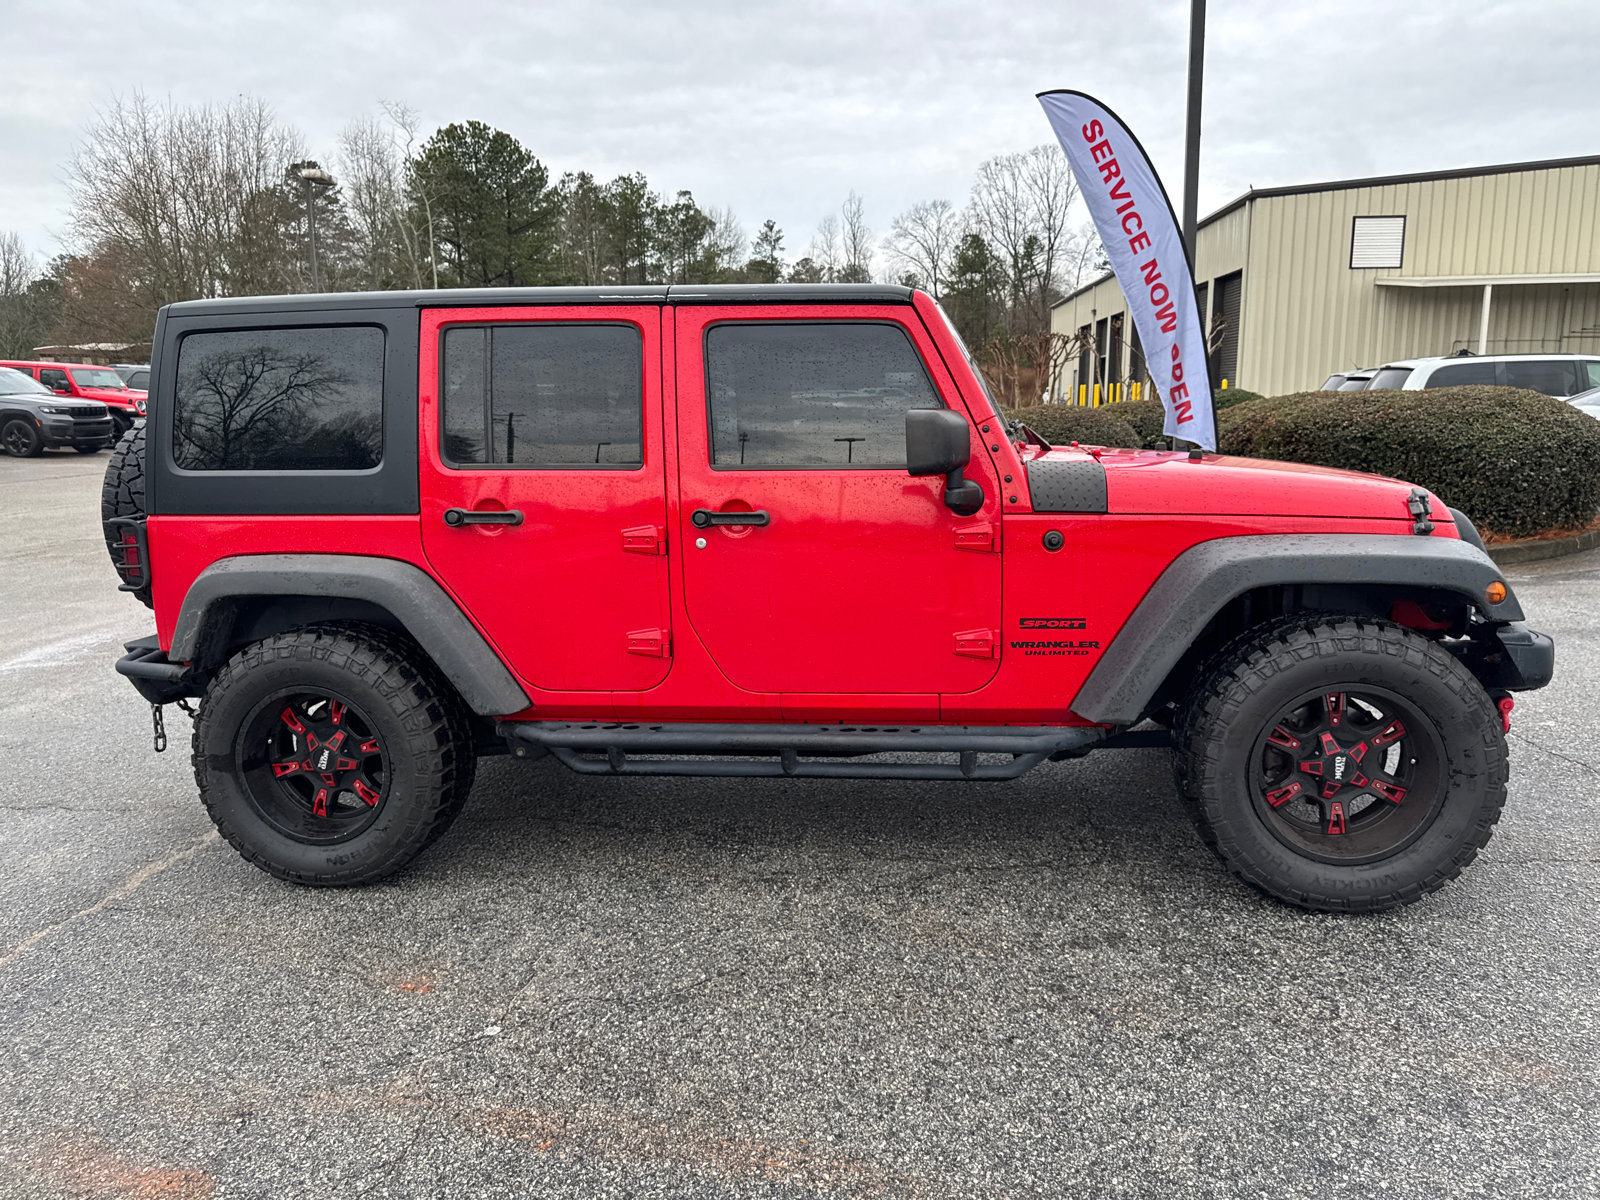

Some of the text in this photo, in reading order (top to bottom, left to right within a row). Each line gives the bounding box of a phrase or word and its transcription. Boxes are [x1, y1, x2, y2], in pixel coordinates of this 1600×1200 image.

[1081, 119, 1152, 255] SERVICE
[1140, 258, 1177, 334] NOW
[1019, 618, 1086, 629] SPORT
[1010, 641, 1100, 649] WRANGLER
